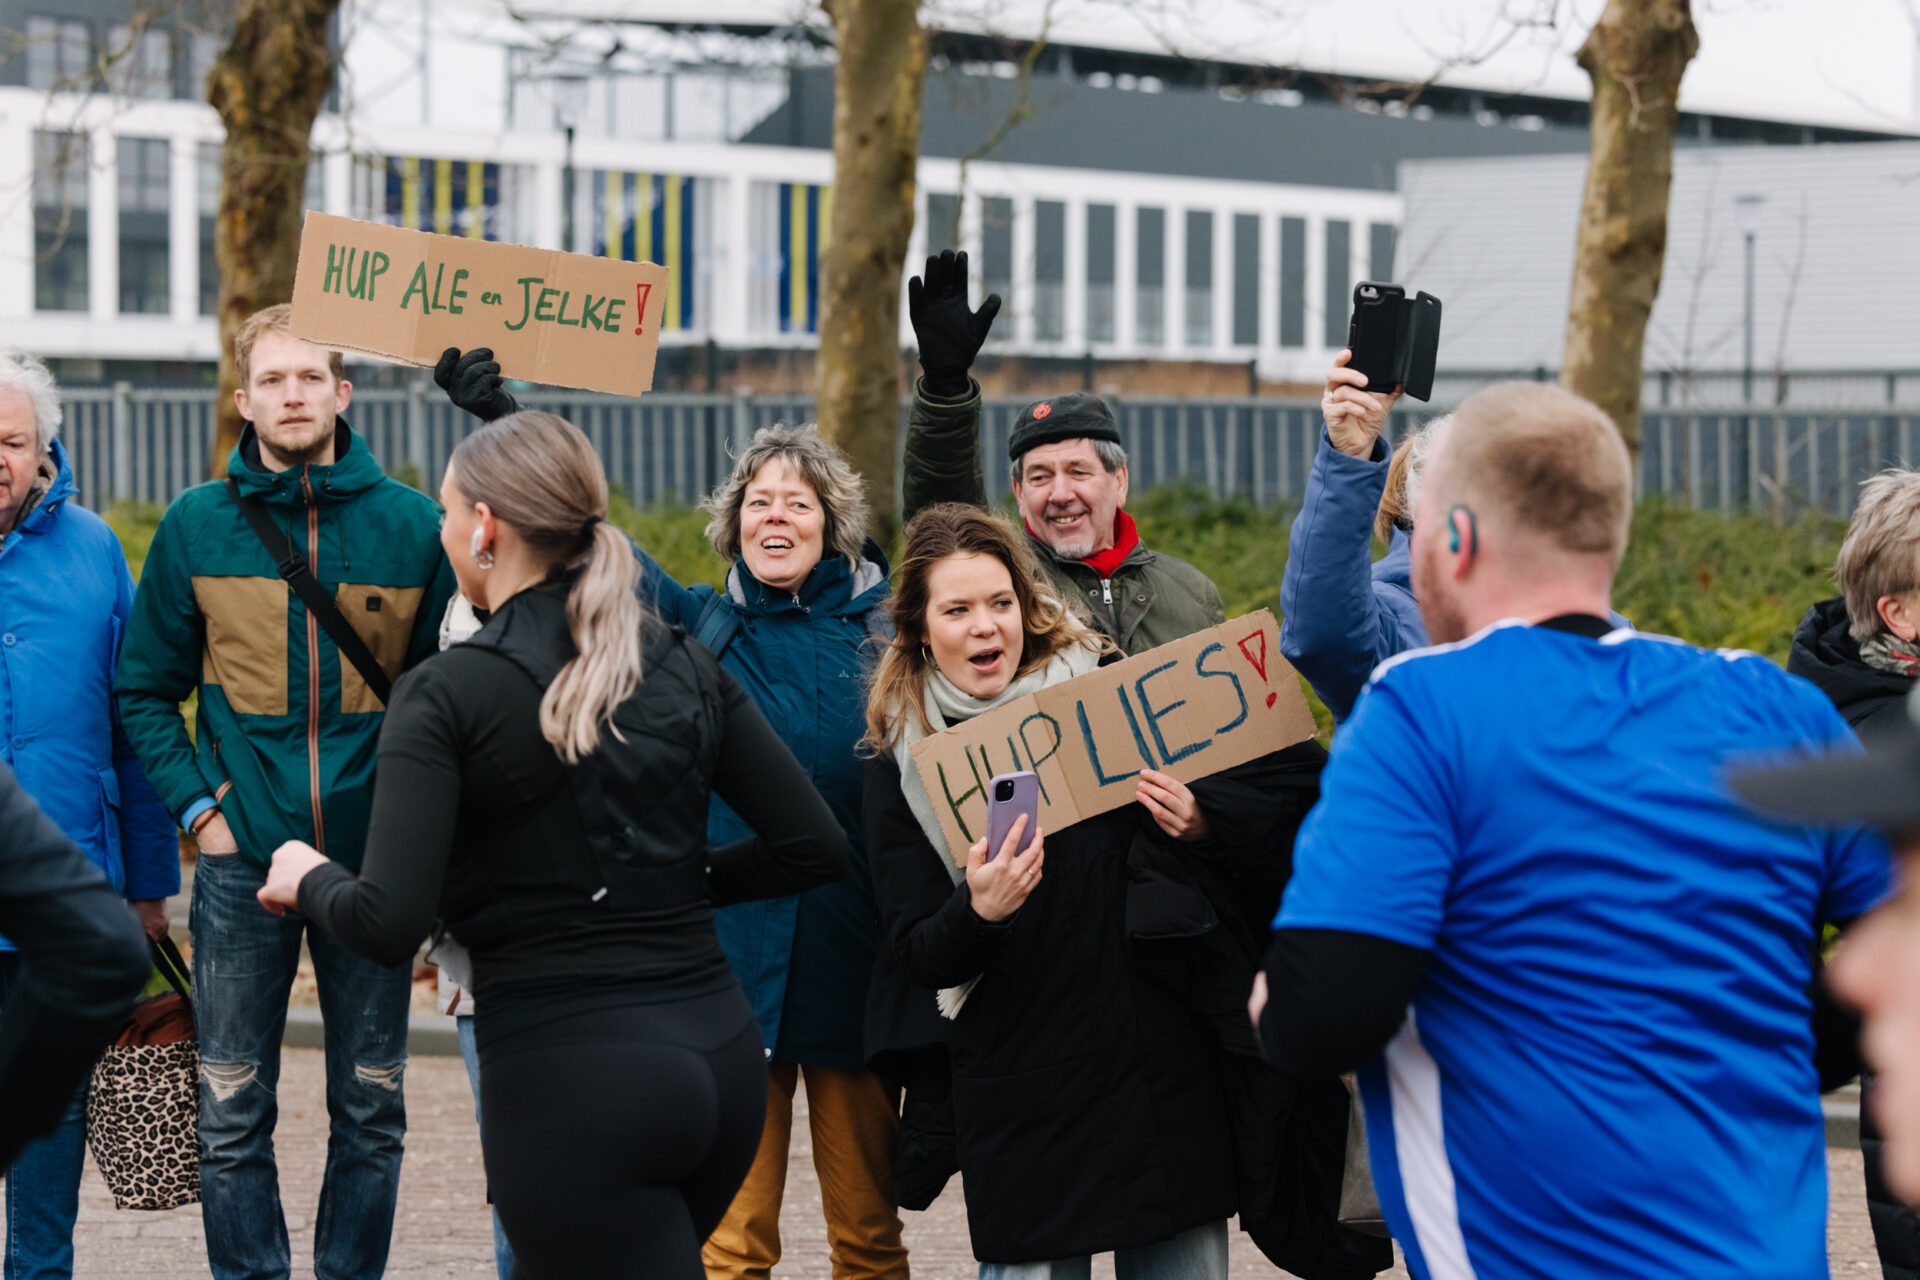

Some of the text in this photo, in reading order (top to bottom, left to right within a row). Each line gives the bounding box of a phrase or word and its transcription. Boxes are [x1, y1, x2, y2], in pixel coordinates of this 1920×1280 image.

[323, 244, 653, 336] HUP ALE en JELKE!
[1075, 628, 1278, 788] LIES!
